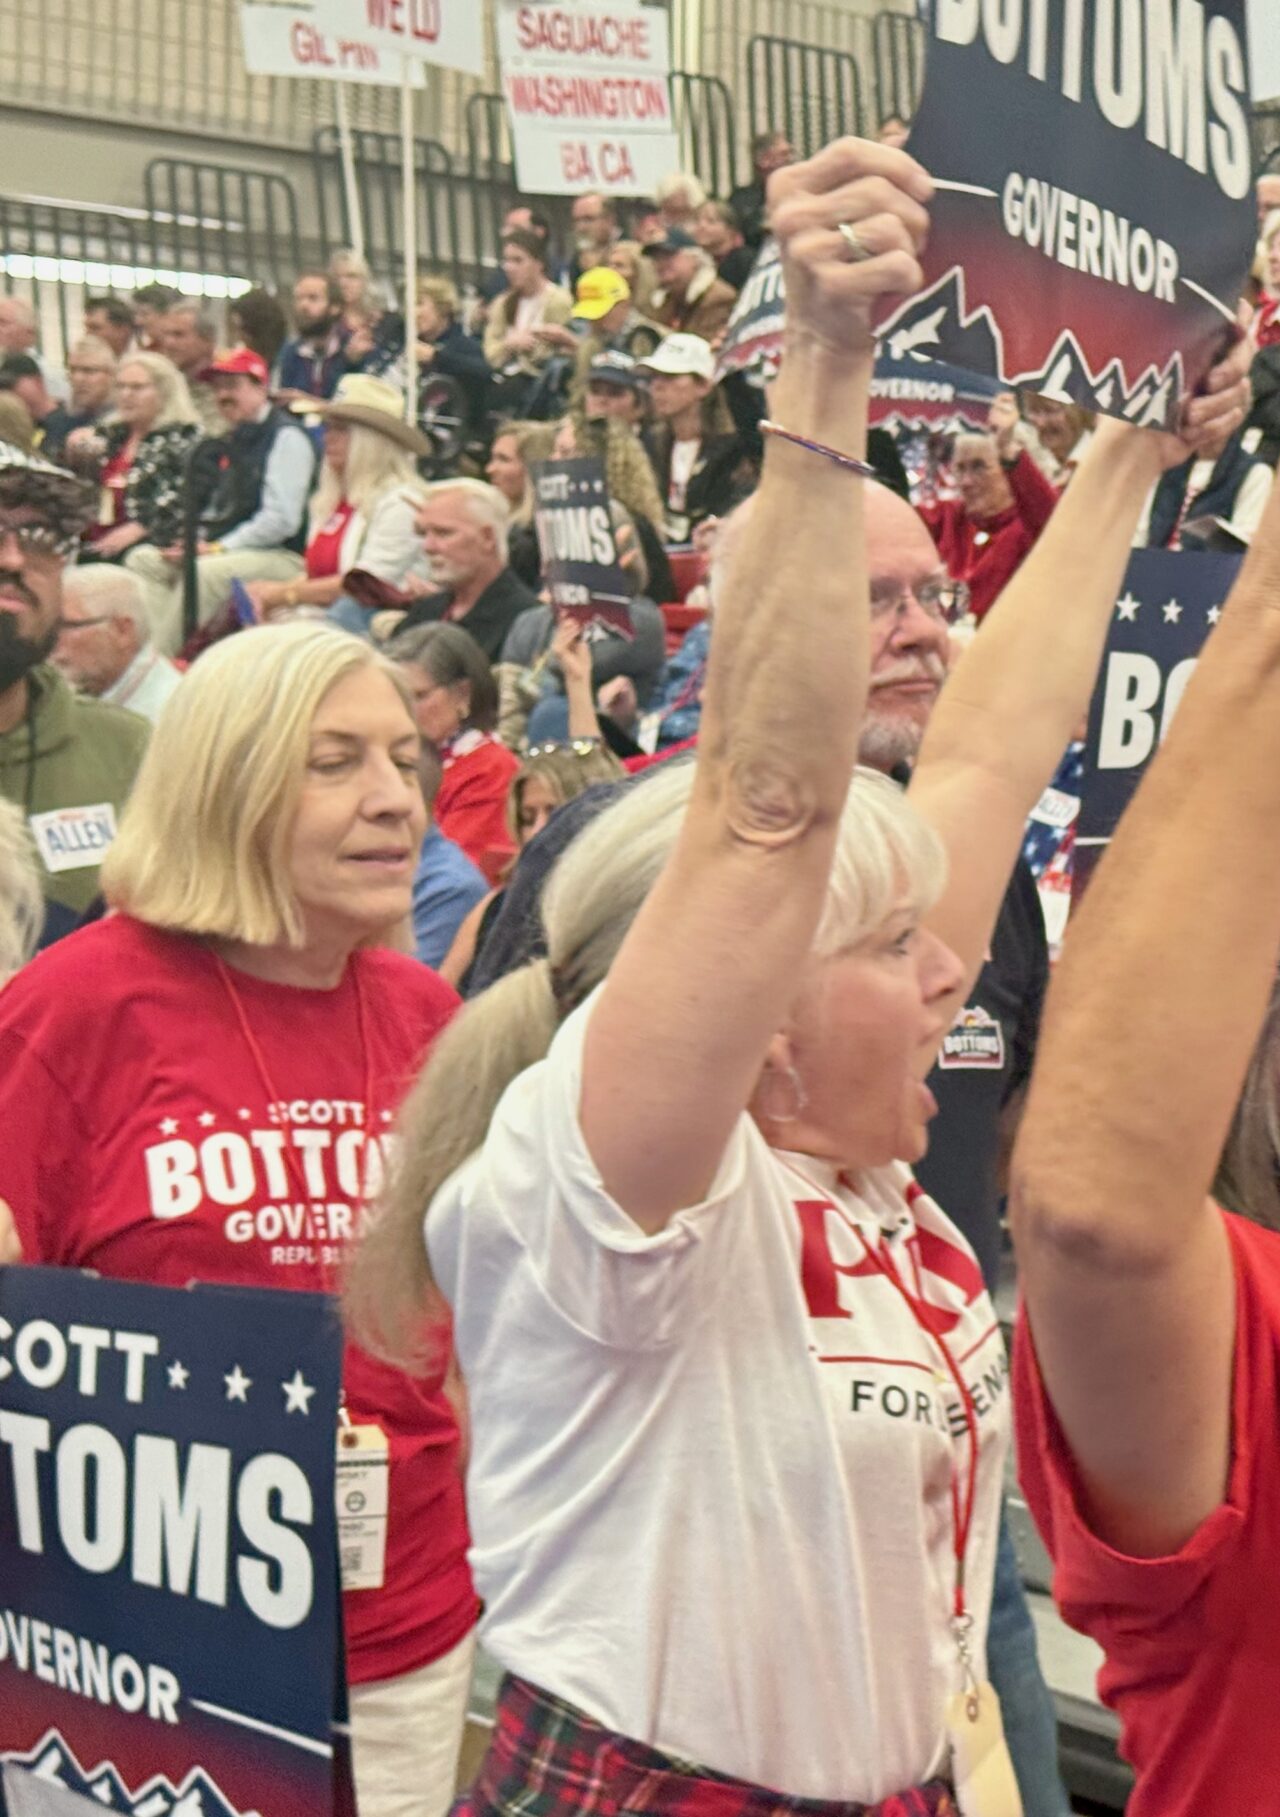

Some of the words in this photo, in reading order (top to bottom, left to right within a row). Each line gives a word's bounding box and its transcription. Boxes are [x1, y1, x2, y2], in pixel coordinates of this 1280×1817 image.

[517, 7, 651, 60] SAGUACHE
[509, 76, 667, 118] WASHINGTON
[1003, 172, 1179, 303] GOVERNOR
[268, 1099, 364, 1125] SCOTT
[0, 1316, 158, 1403] OTT
[851, 1379, 932, 1425] FOR
[0, 1409, 314, 1629] TOMS
[0, 1609, 180, 1723] VERNOR
